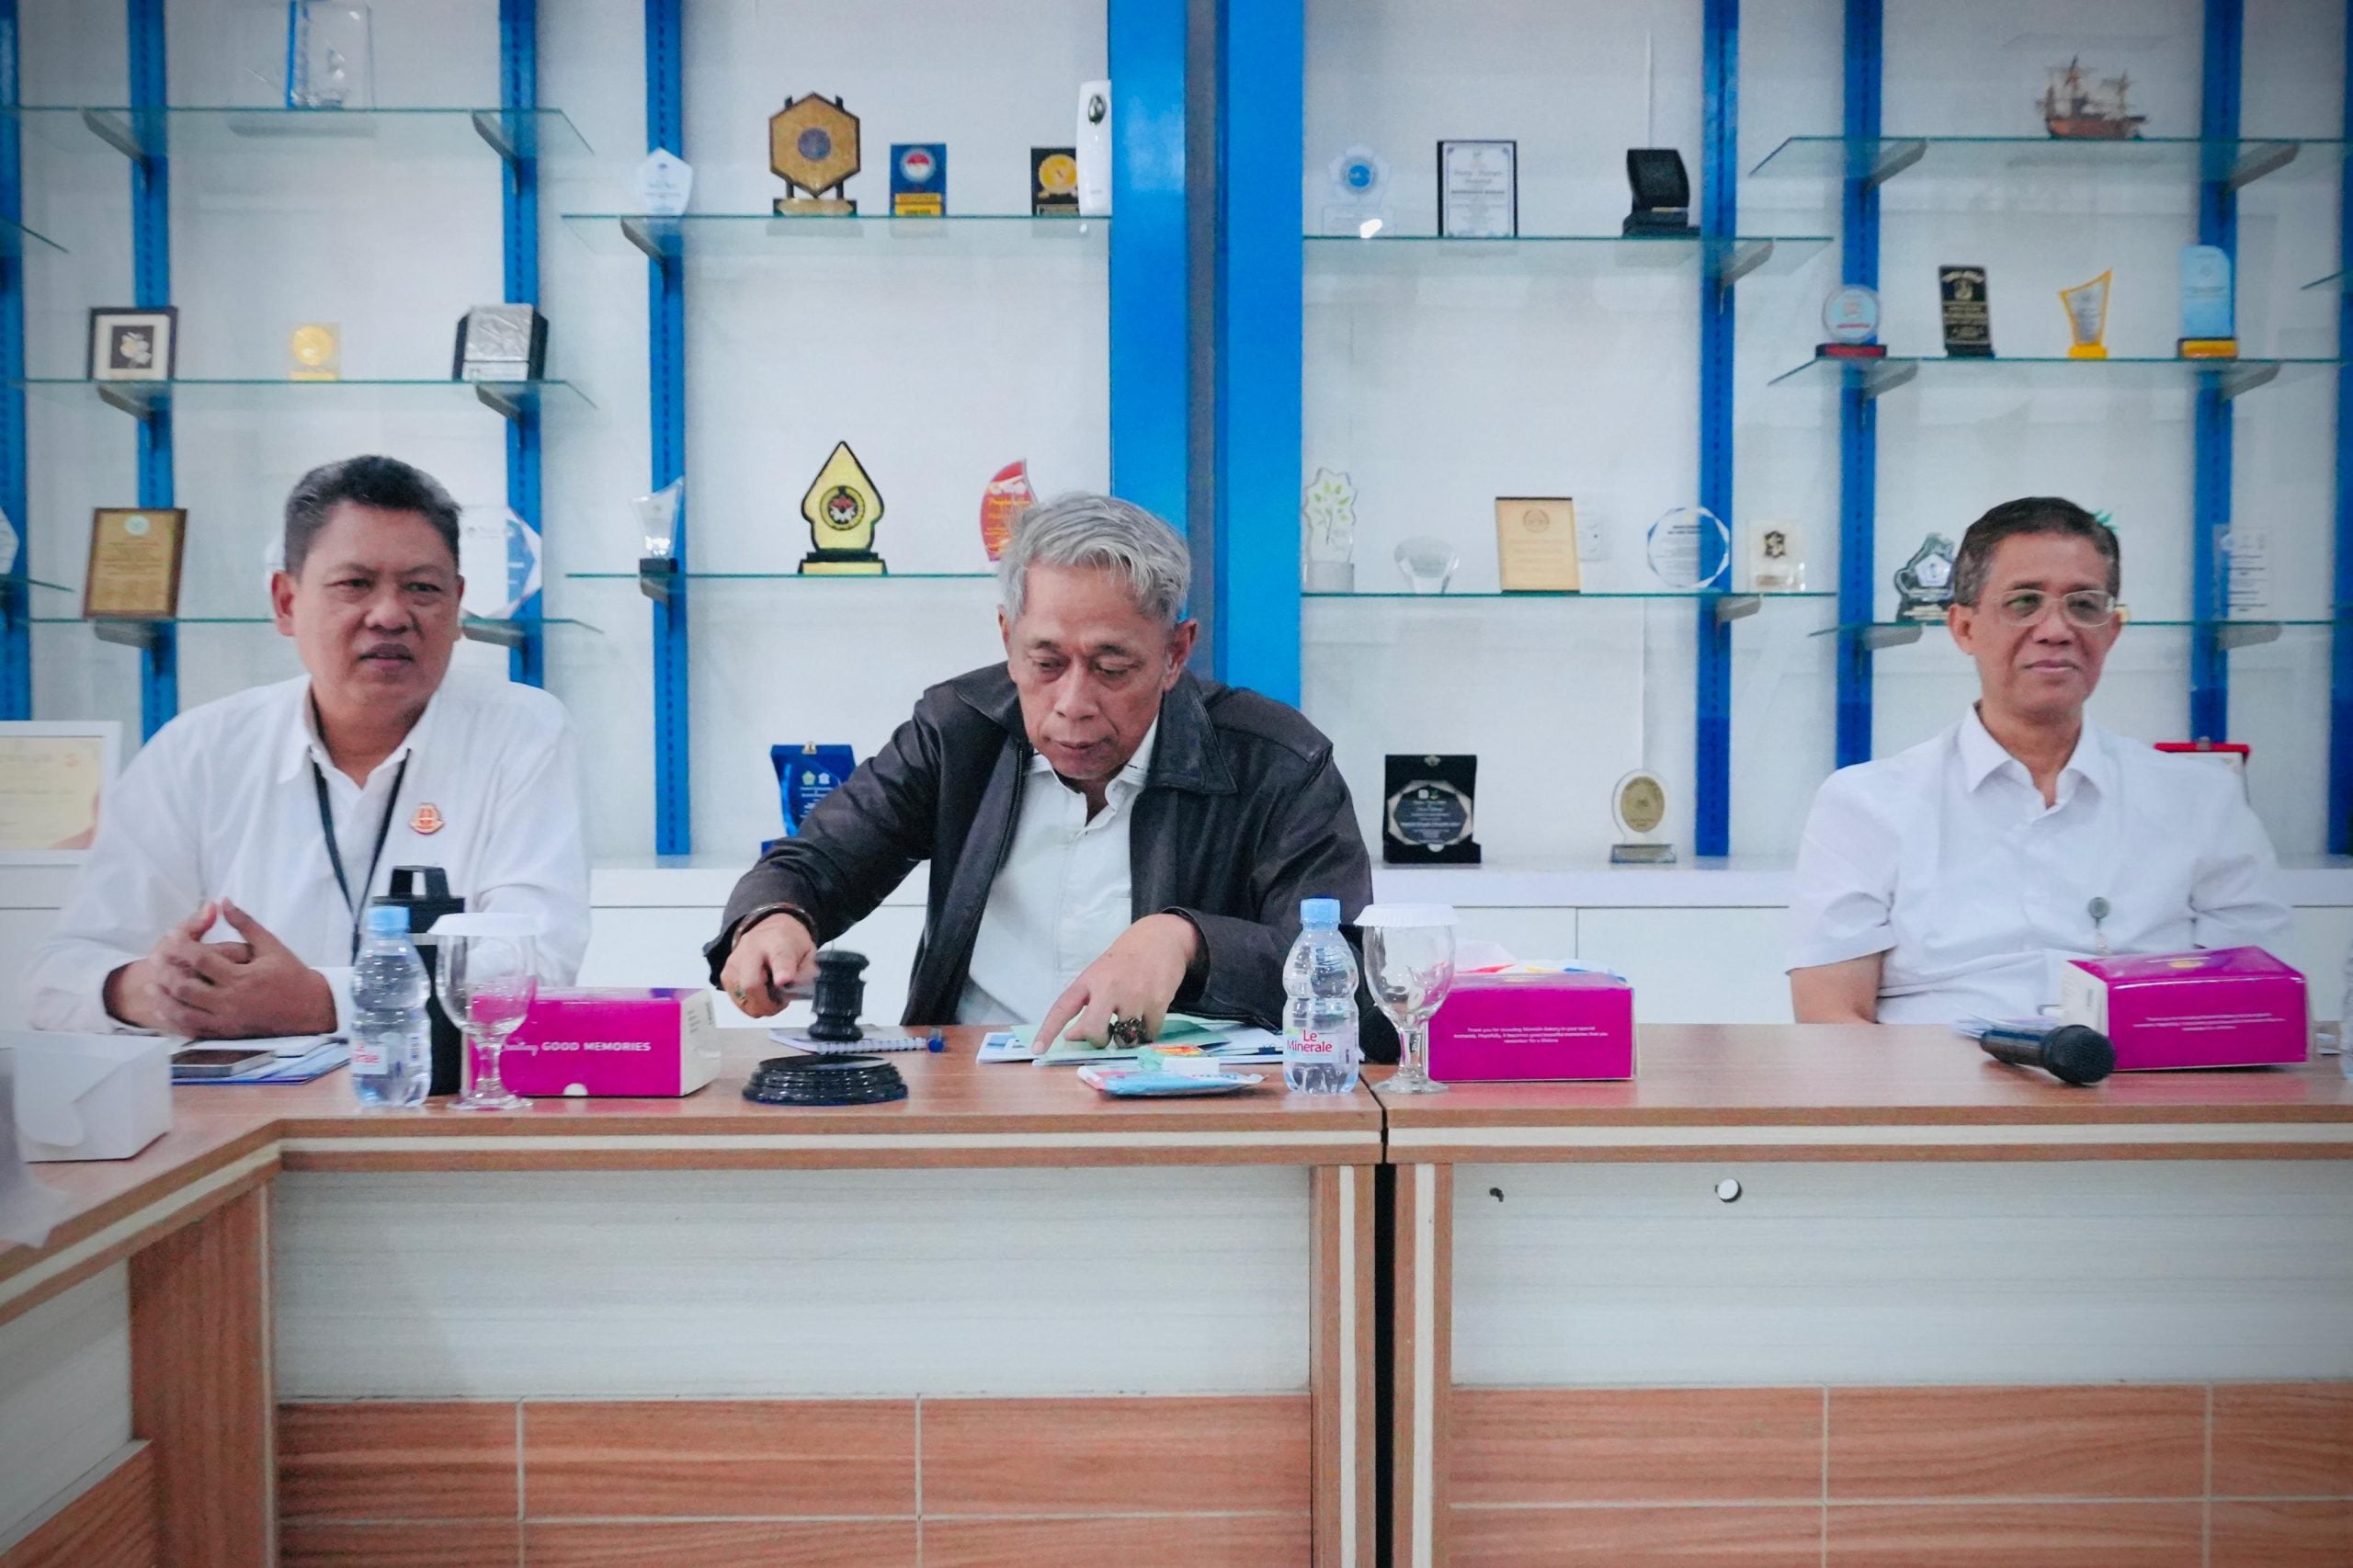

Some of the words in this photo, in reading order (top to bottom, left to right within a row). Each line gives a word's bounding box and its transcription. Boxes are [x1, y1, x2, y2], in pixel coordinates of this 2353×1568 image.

[1303, 1029, 1318, 1041] Le
[540, 1041, 580, 1051] GOOD
[583, 1041, 652, 1051] MEMORIES
[1287, 1040, 1333, 1052] Minerale
